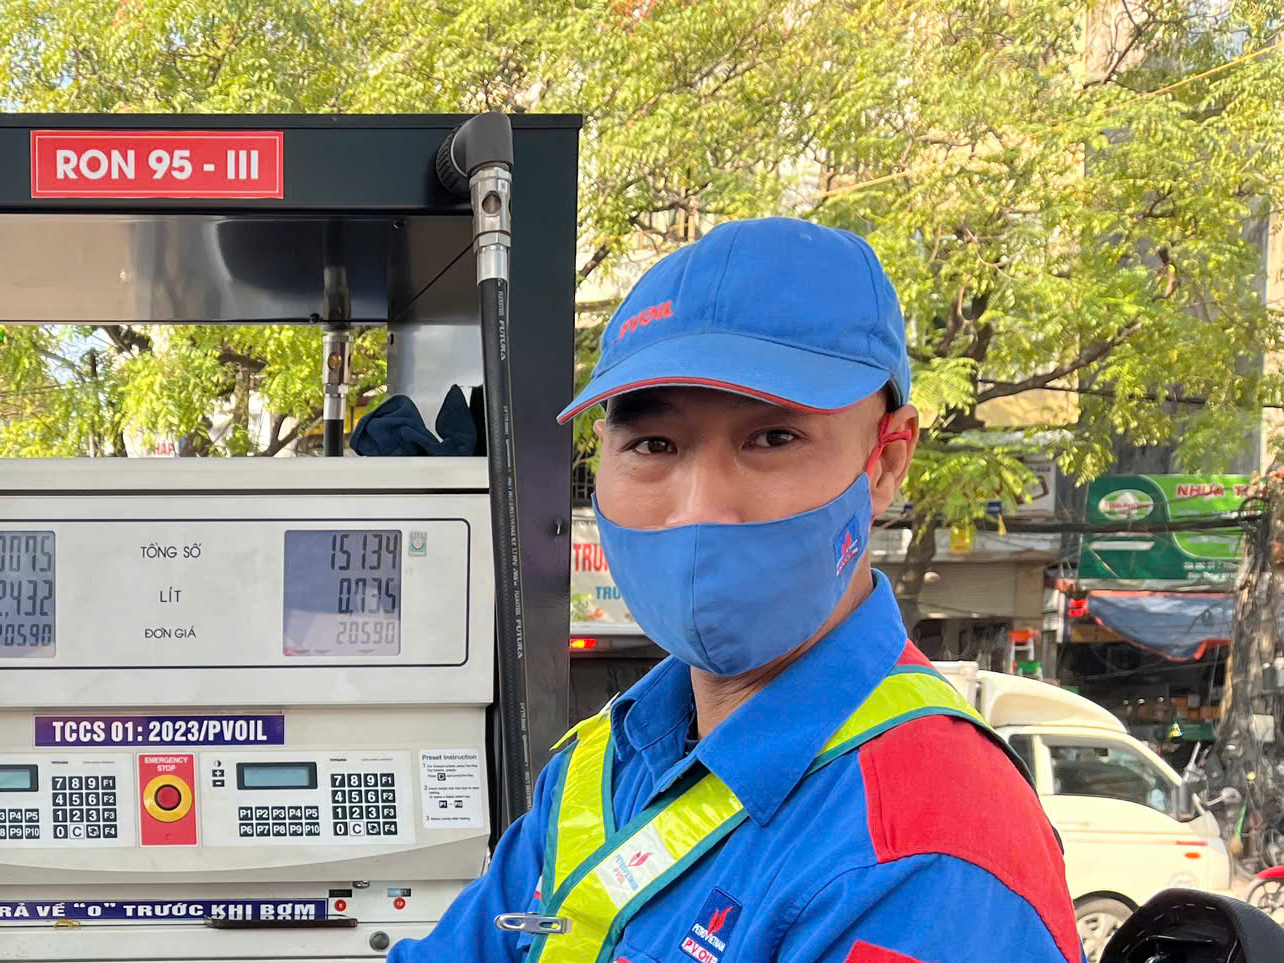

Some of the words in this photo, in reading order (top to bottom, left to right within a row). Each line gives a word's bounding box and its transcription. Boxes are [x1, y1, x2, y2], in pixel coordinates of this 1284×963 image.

[56, 149, 136, 180] RON
[147, 149, 193, 180] 95
[226, 149, 259, 180] III
[613, 299, 675, 345] PVOIL
[499, 320, 507, 361] FUTURA
[140, 541, 178, 559] TỔNG
[183, 542, 202, 559] SỐ
[330, 533, 399, 571] 15134
[573, 543, 609, 572] TRU
[159, 586, 182, 603] LÍT
[337, 577, 397, 617] 0,735
[144, 626, 171, 639] ĐƠN
[174, 624, 197, 639] GIÁ
[336, 621, 396, 645] 20590
[515, 619, 524, 660] FUTURA
[52, 720, 106, 743] TCCS
[111, 720, 144, 743] 01:
[148, 719, 268, 742] 2023/PVOIL
[144, 756, 188, 765] EMERGENCY
[157, 764, 176, 772] STOP
[55, 778, 63, 788] 7
[71, 778, 79, 788] 8
[88, 778, 96, 788] 9
[103, 779, 113, 787] F1
[334, 775, 342, 785] 7
[350, 775, 358, 785] 8
[367, 775, 375, 785] 9
[382, 776, 392, 785] F1
[55, 794, 63, 804] 4
[72, 794, 80, 804] 5
[88, 794, 96, 804] 6
[103, 795, 114, 803] F2
[334, 792, 343, 802] 4
[351, 792, 359, 802] 5
[367, 792, 376, 802] 6
[383, 792, 393, 801] F2
[9, 812, 22, 821] P4
[25, 811, 38, 820] P5
[57, 810, 63, 820] 1
[72, 810, 81, 820] 2
[88, 810, 97, 820] 3
[104, 811, 115, 819] F3
[240, 809, 252, 818] P1
[256, 809, 268, 818] P2
[272, 809, 285, 818] P3
[289, 809, 302, 818] P4
[305, 808, 318, 817] P5
[337, 808, 343, 818] 1
[352, 808, 361, 817] 2
[368, 808, 377, 817] 3
[383, 808, 395, 817] F3
[10, 828, 22, 837] P9
[25, 828, 40, 837] P10
[56, 827, 64, 837] 0
[72, 827, 82, 837] C
[104, 827, 115, 836] F4
[240, 825, 253, 834] P6
[257, 825, 269, 834] P7
[273, 825, 286, 834] P8
[290, 825, 302, 834] P9
[305, 825, 320, 834] P10
[336, 824, 344, 834] 0
[352, 824, 362, 834] C
[384, 824, 396, 833] F4
[35, 901, 66, 917] VỀ
[123, 901, 204, 917] TRƯỚC
[211, 903, 252, 920] KHI
[260, 902, 316, 920] BƠM
